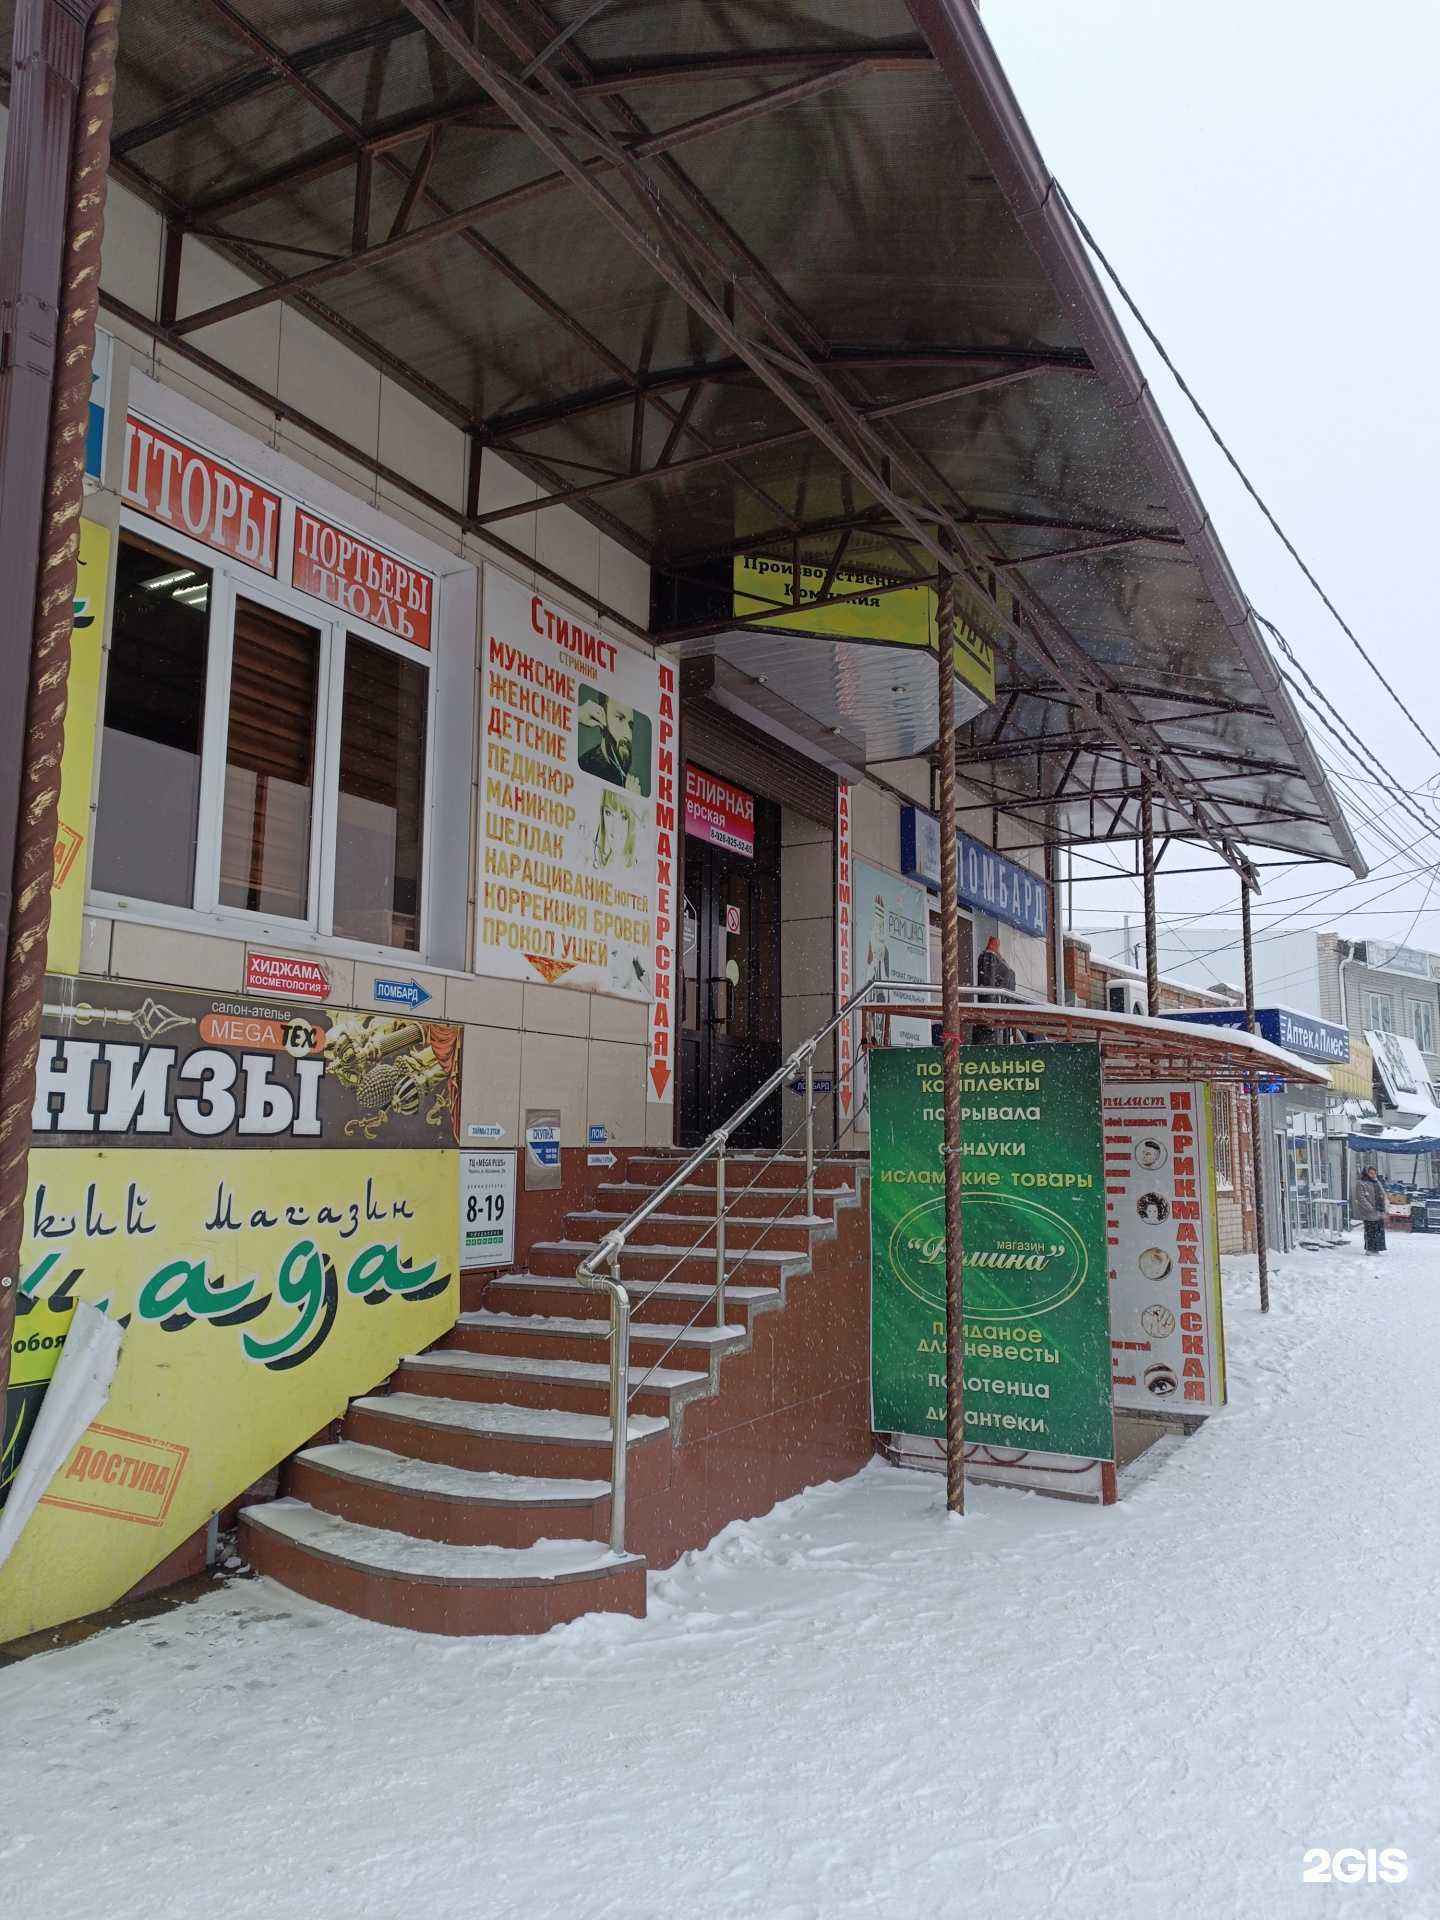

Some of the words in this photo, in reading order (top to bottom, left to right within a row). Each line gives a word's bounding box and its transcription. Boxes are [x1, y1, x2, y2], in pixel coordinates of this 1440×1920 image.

[299, 515, 429, 615] ПОРТЬЕРЫ
[313, 566, 415, 639] ТЮЛЬ
[489, 637, 576, 703] МУЖСКИЕ
[488, 670, 573, 732] ЖЕНСКИЕ
[487, 705, 567, 763] ДЕТСКИЕ
[487, 742, 575, 797] ПЕДИКЮР
[486, 777, 577, 830] МАНИКЮР
[686, 769, 754, 823] ЕЛИРНАЯ
[686, 797, 726, 828] ерская
[484, 846, 615, 906] НАРАЩИВАНИЕ
[652, 663, 674, 1057] ПАРИКМАХЕРСКАЯ
[484, 881, 588, 932] КОРРЕКЦИЯ
[593, 911, 650, 948] БРОВЕЙ
[482, 916, 555, 957] ПРОКОЛ
[561, 932, 608, 968] УШЕЙ
[249, 975, 321, 992] КОСМЕТОЛОГИЯ
[250, 957, 321, 981] ХИДЖАМА
[211, 1001, 291, 1021] салон-ателье
[378, 983, 419, 1003] ЛОМБАРД
[210, 1020, 276, 1044] MEGA
[33, 1038, 325, 1136] НИЗЫ
[916, 1059, 1046, 1076] потельные
[922, 1106, 1041, 1121] порывала
[938, 1142, 1026, 1157] сндуки
[880, 1170, 1001, 1186] исламкие
[1011, 1171, 1093, 1188] товары
[466, 1194, 504, 1222] 8-19
[996, 1241, 1045, 1251] магазин
[1168, 1091, 1205, 1401] ПАРИКМАХЕРСКАЯ
[964, 1342, 1060, 1364] невесты
[928, 1373, 1050, 1399] поотенца
[926, 1406, 1045, 1432] диантеки
[65, 1446, 174, 1495] ДОСТУПА
